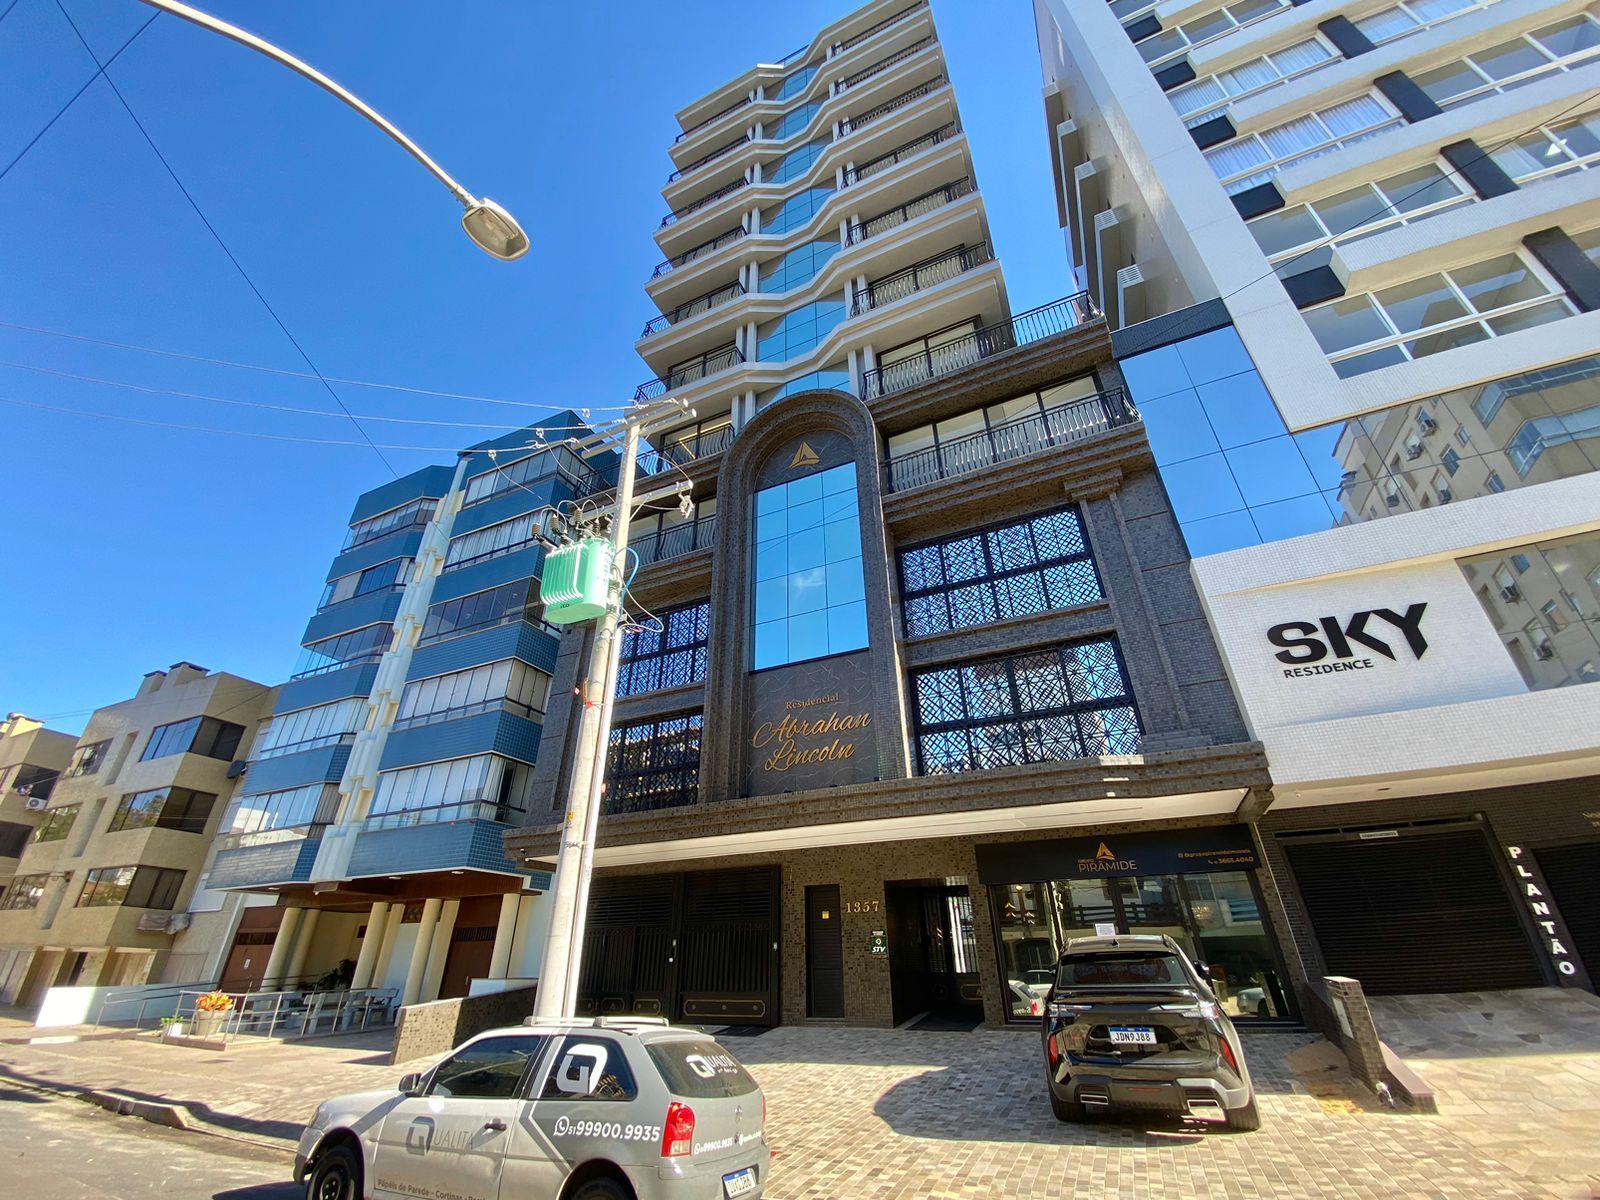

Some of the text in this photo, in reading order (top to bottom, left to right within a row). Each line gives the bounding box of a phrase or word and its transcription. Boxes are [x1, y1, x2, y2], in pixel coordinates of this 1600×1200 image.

[1266, 602, 1429, 664] SKY
[1283, 659, 1374, 679] RESIDENCE
[785, 693, 840, 710] Residencial
[752, 711, 873, 749] Abrahan
[764, 738, 855, 773] Lincoln
[846, 900, 880, 913] 1357
[1508, 846, 1576, 975] PLANTÃO
